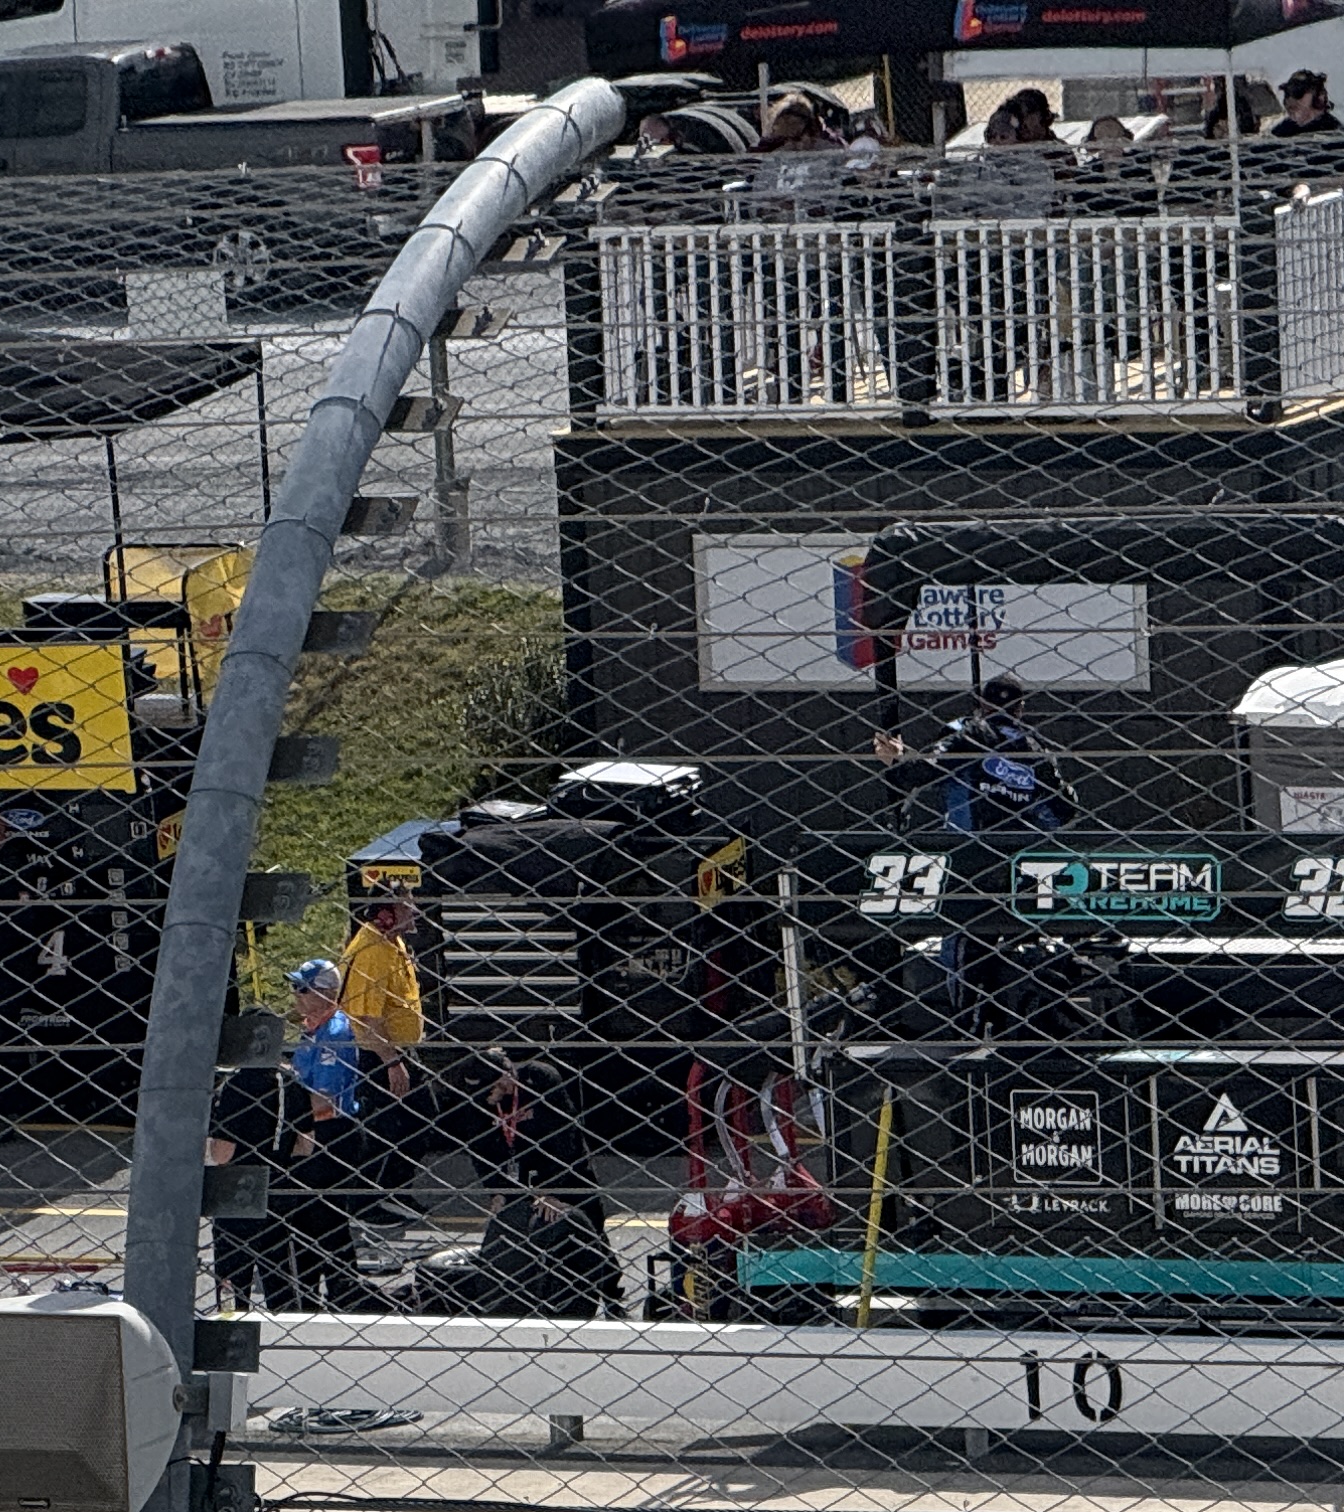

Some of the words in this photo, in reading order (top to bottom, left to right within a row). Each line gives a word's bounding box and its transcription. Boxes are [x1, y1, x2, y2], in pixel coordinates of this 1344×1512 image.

[918, 588, 1004, 606] aware
[859, 854, 948, 914] 33
[1090, 862, 1211, 891] TEAM
[1020, 1107, 1092, 1131] MORGAN
[1021, 1143, 1093, 1169] MORGAN
[1174, 1135, 1281, 1155] AERIAL
[1174, 1155, 1281, 1176] TITANS
[1175, 1193, 1221, 1211] MORE
[1239, 1194, 1283, 1212] CORE
[1020, 1350, 1122, 1422] 10
